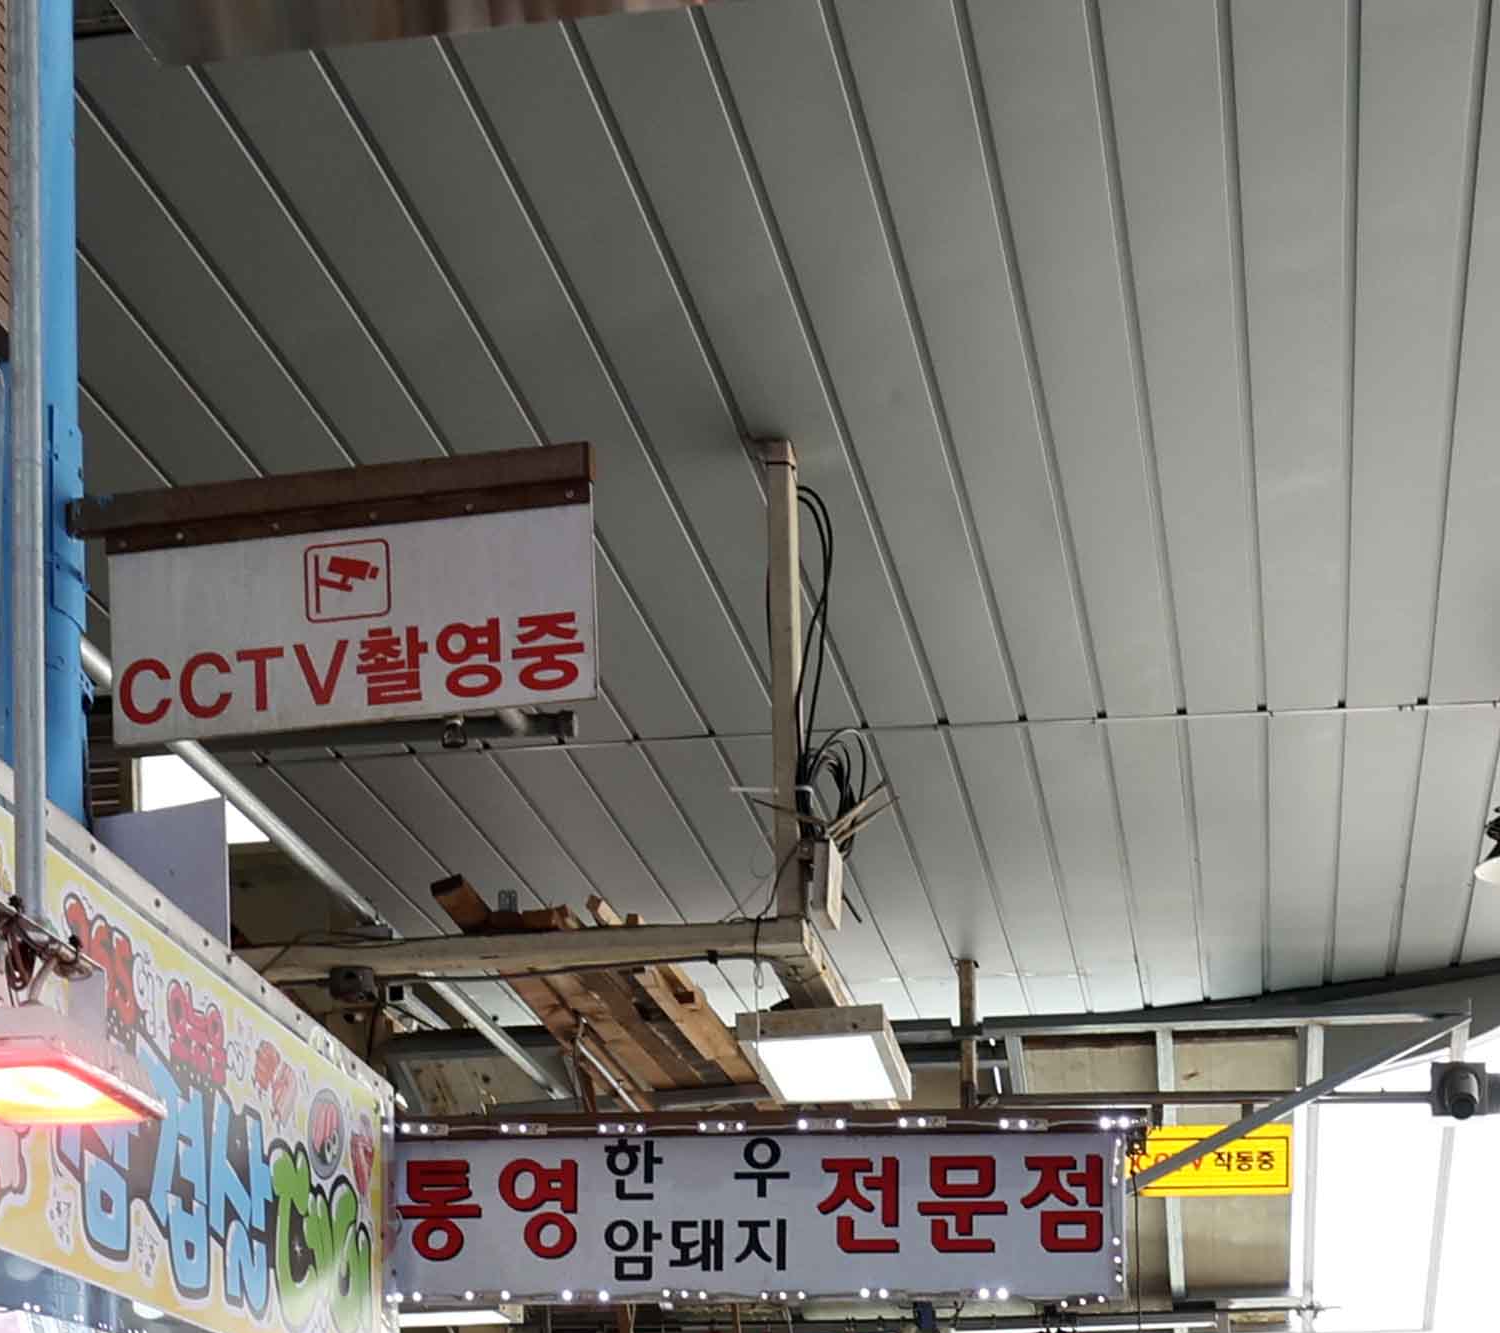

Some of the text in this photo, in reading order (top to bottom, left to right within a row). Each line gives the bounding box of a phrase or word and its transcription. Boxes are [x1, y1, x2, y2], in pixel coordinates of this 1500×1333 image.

[399, 1154, 1104, 1262] 통영 전문점
[604, 1217, 791, 1283] 암돼지
